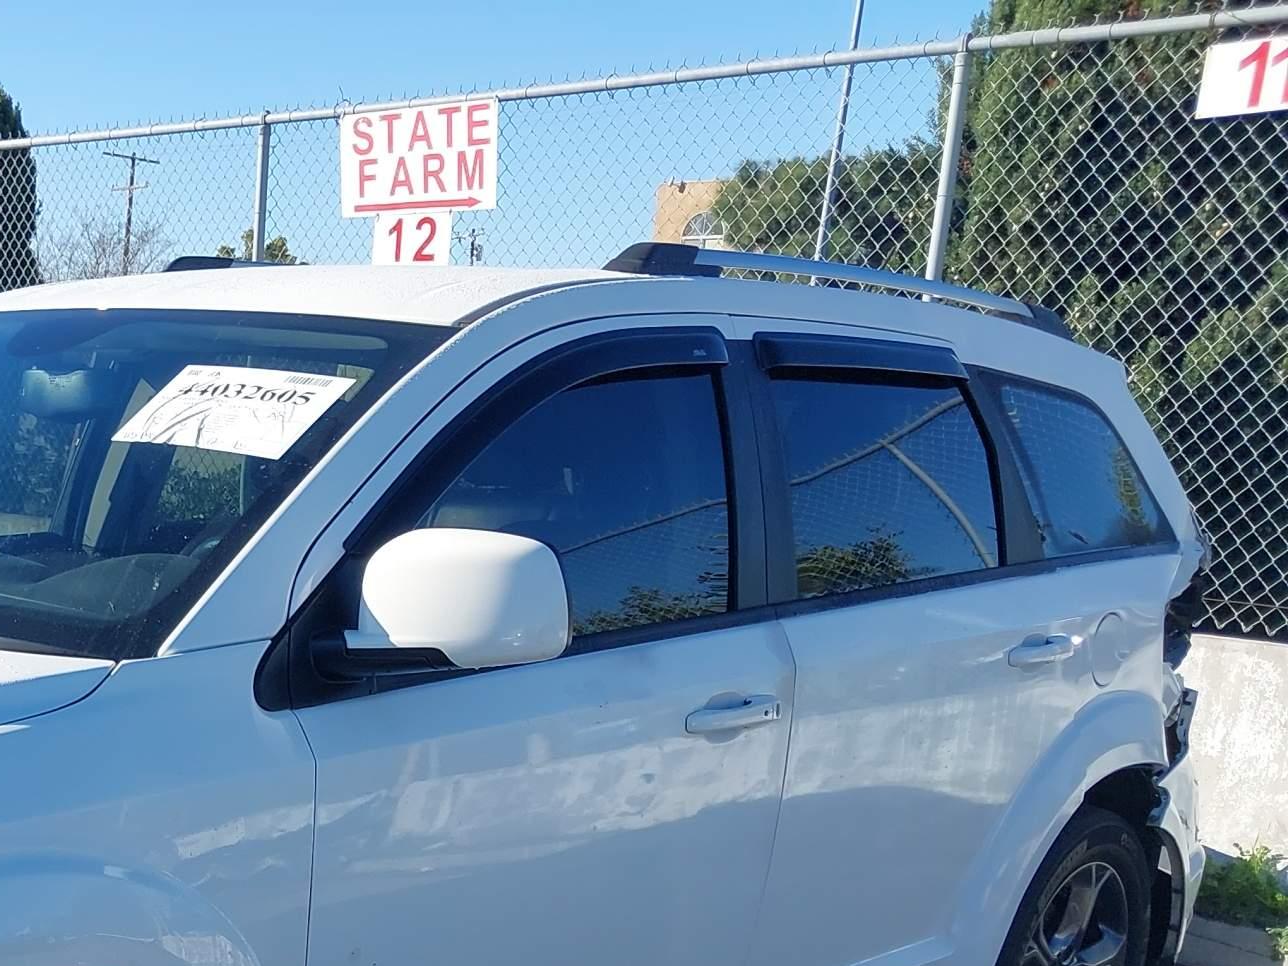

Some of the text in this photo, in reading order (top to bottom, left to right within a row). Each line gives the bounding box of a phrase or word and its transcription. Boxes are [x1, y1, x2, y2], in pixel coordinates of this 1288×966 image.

[352, 103, 491, 156] STATE
[358, 148, 485, 198] FARM
[388, 216, 437, 262] 12
